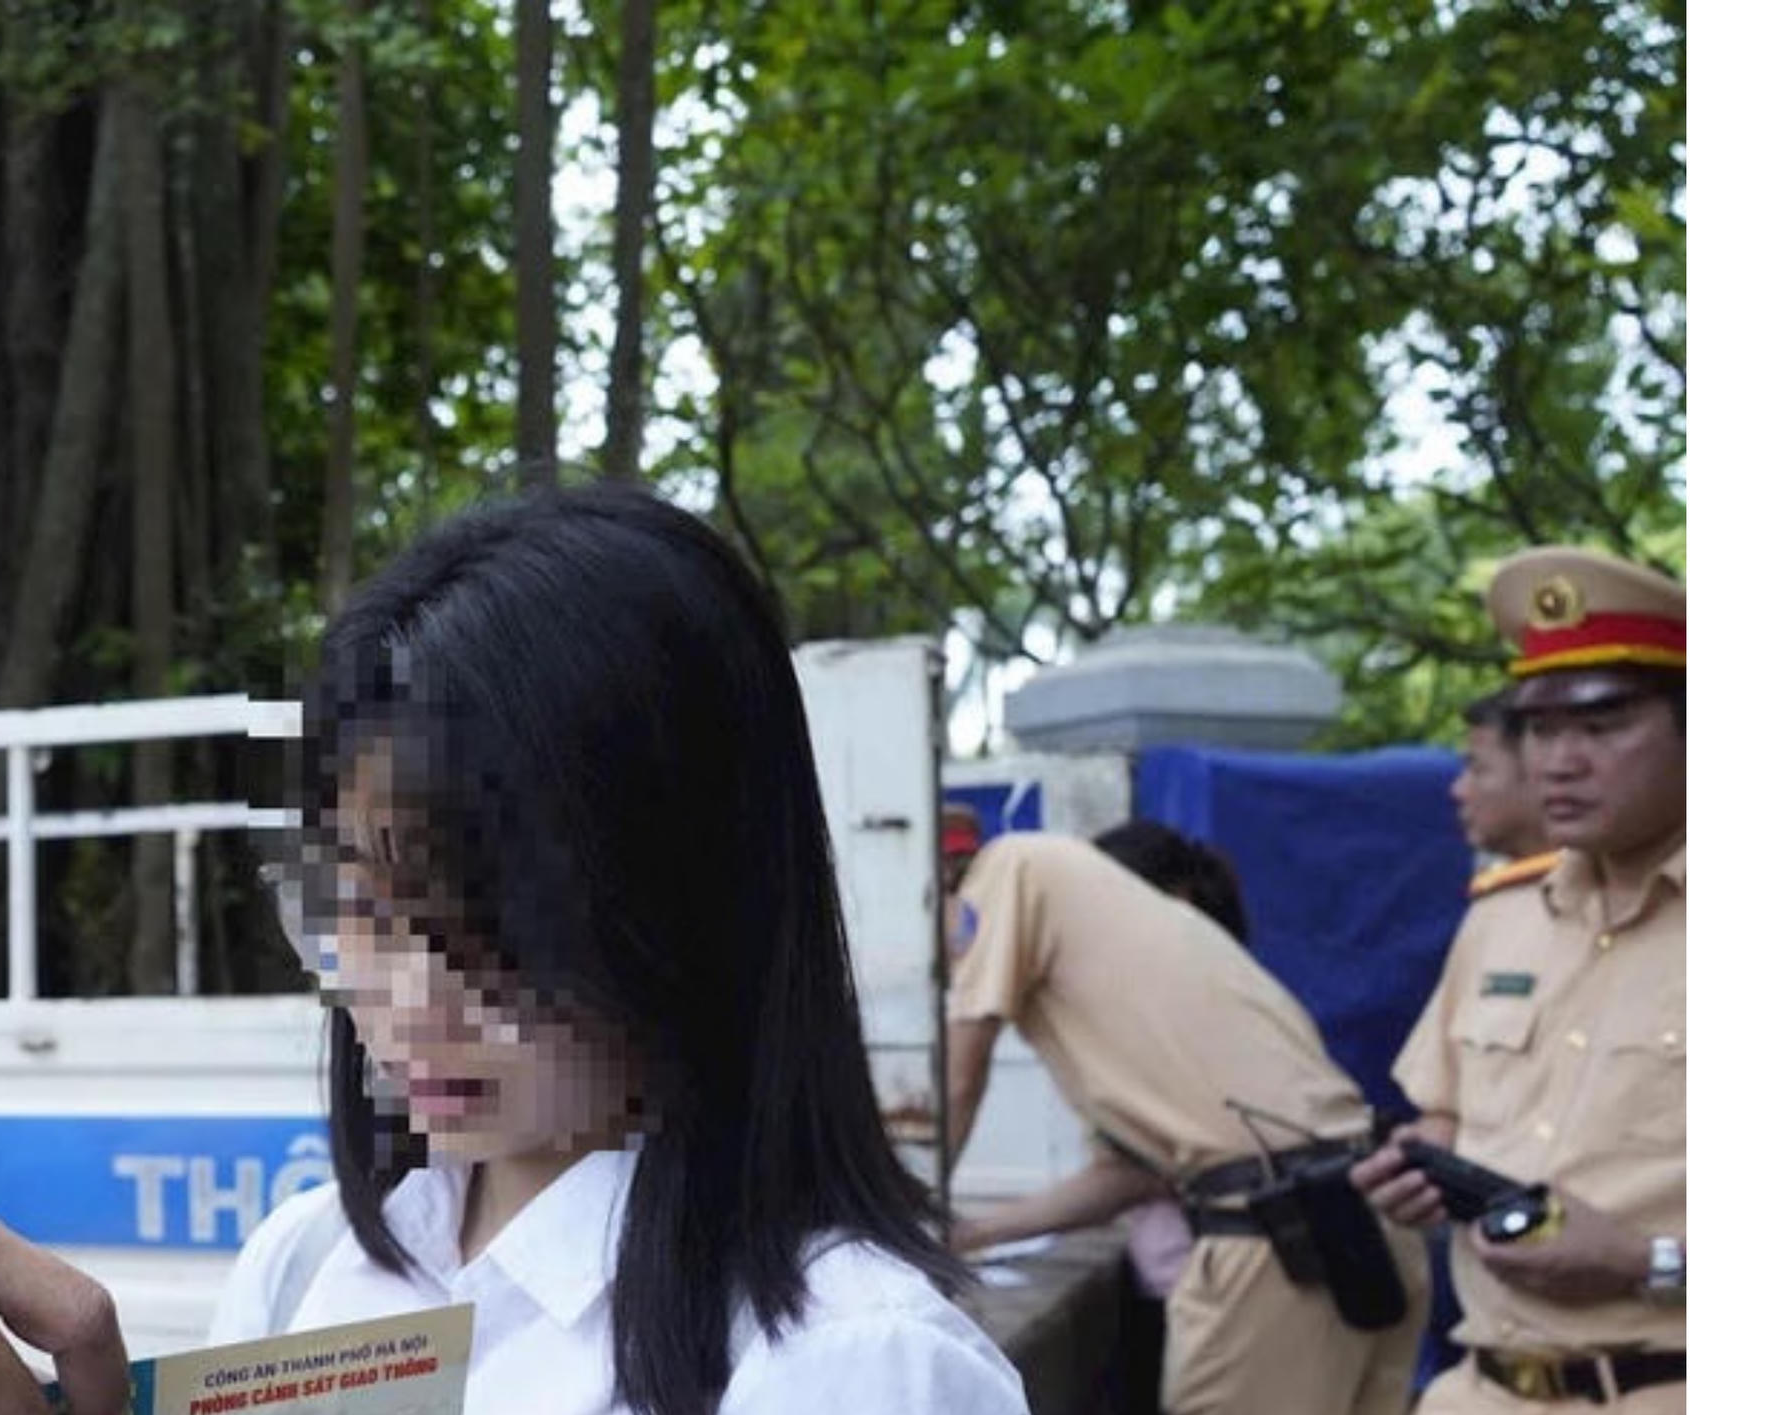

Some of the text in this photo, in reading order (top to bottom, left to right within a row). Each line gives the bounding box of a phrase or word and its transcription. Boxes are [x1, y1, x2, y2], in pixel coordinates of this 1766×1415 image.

[204, 1364, 251, 1388] CÔNG
[254, 1363, 278, 1380] AN
[282, 1353, 336, 1375] THÀNH
[251, 1379, 301, 1408] CẢNH
[302, 1372, 337, 1400] SÁT
[339, 1367, 379, 1392] GIAO
[383, 1356, 439, 1383] THÔNG
